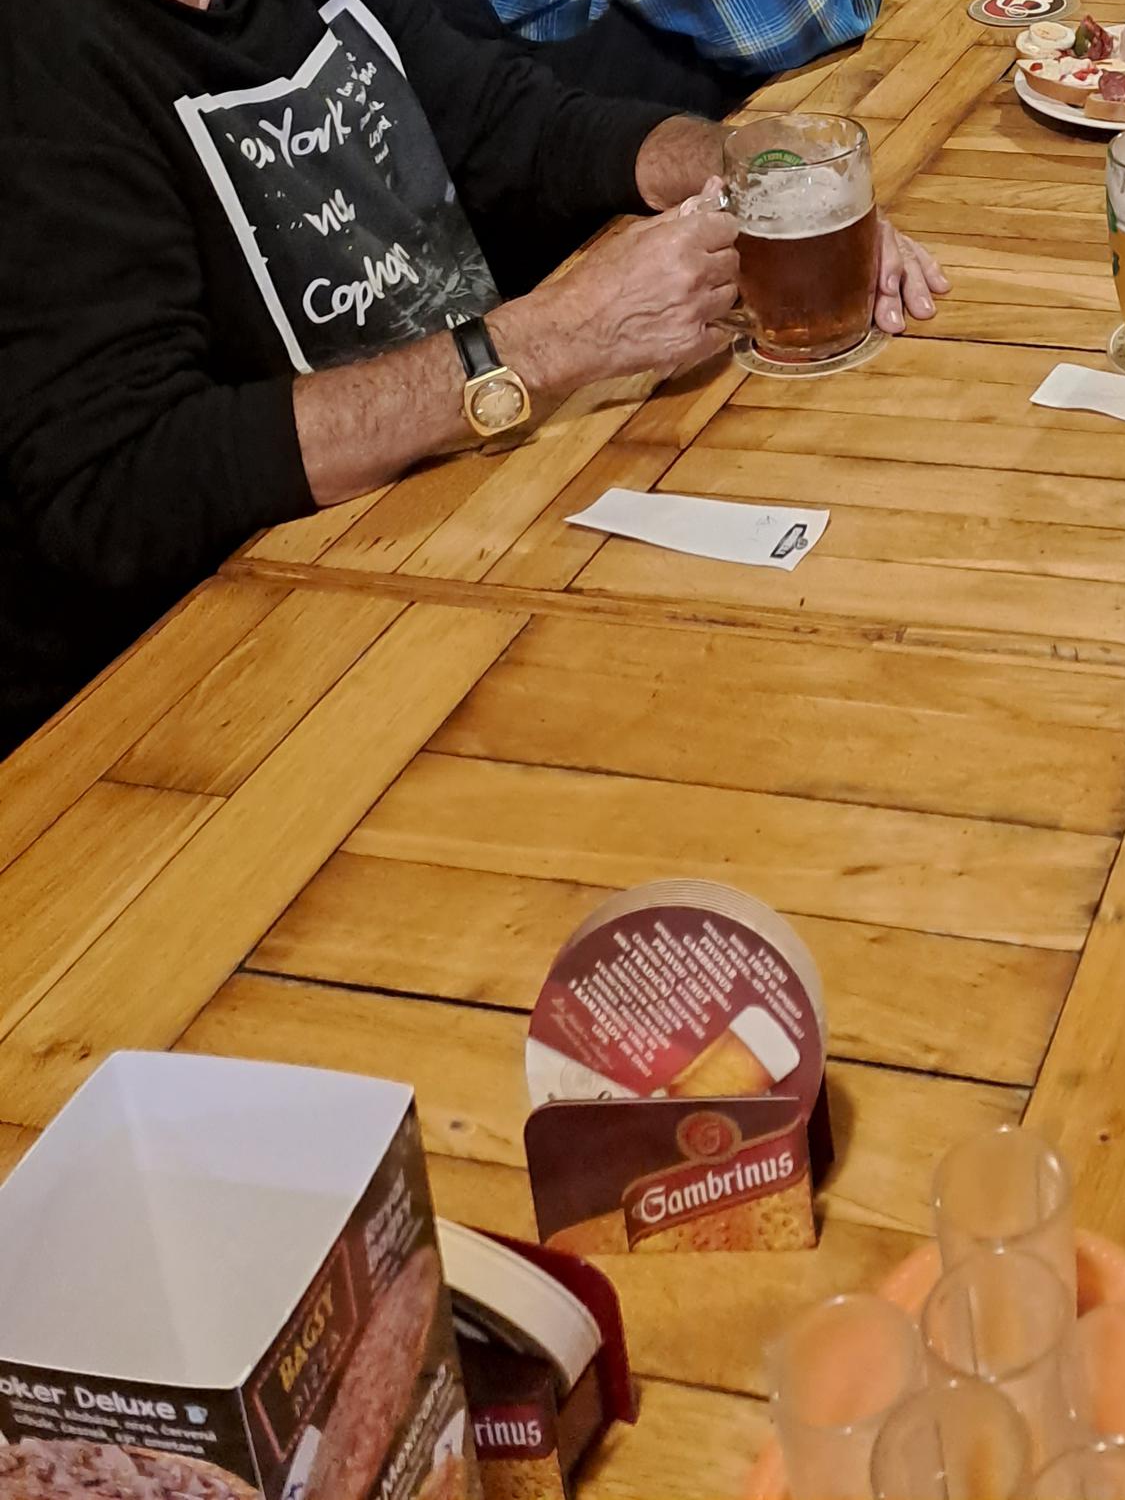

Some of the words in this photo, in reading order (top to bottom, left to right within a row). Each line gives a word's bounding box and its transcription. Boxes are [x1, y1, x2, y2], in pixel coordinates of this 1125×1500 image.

[679, 933, 735, 993] GAMBRINUS
[696, 934, 739, 980] PIVOVAR
[632, 1151, 793, 1223] Gambrinus
[0, 1376, 66, 1405] oker
[74, 1386, 177, 1421] Deluxe
[474, 1416, 542, 1448] rinus
